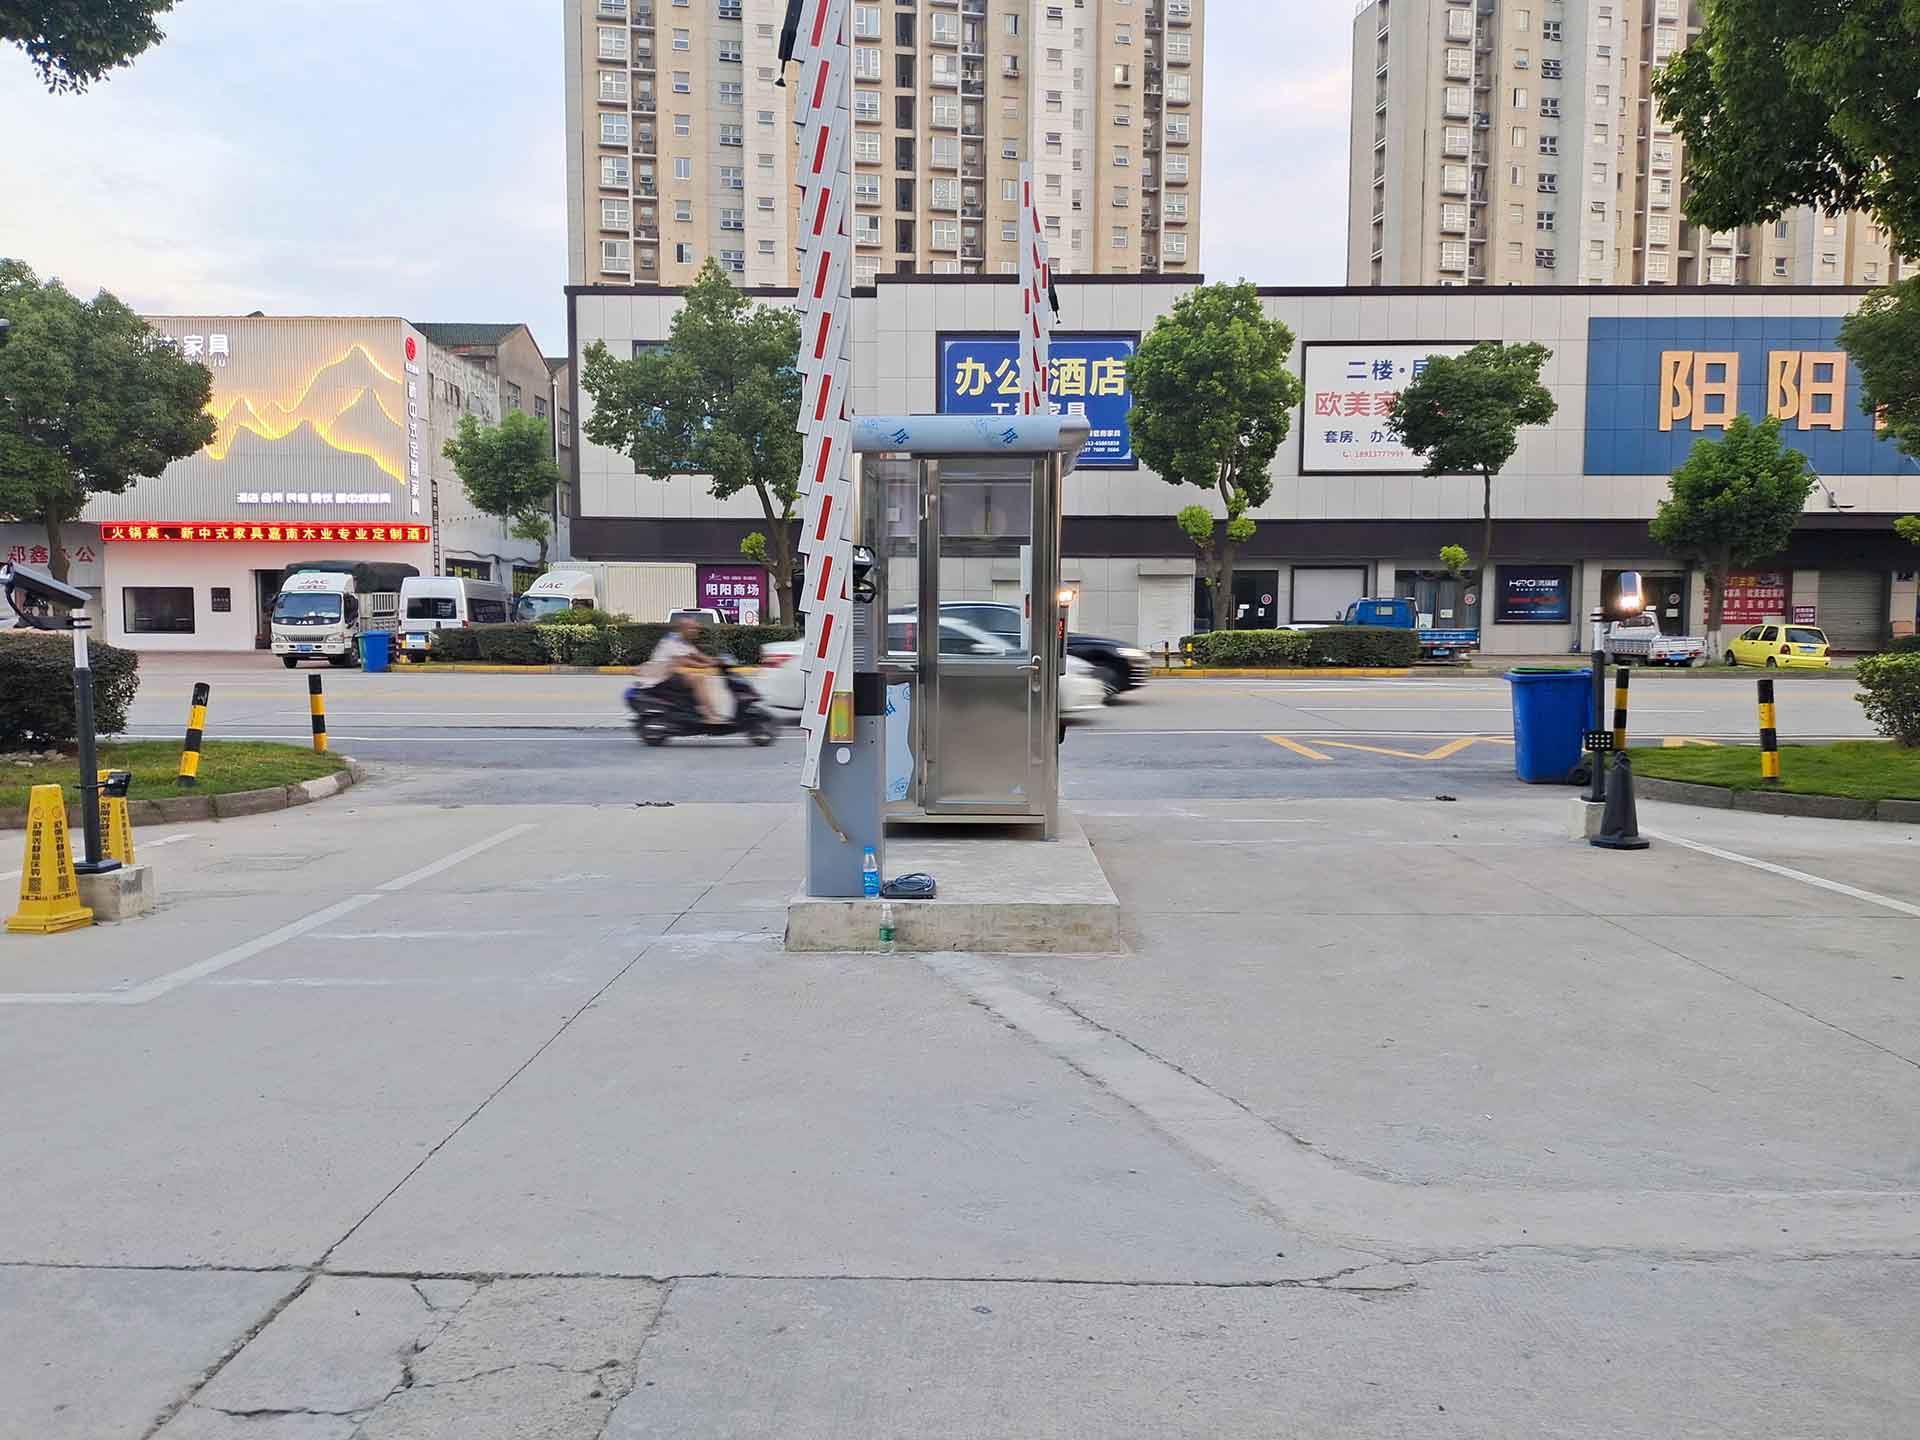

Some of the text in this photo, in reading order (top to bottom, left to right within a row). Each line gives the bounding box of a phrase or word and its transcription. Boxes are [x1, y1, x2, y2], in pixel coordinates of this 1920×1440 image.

[1658, 351, 1889, 431] 阳阳
[705, 583, 760, 596] 阳阳商场
